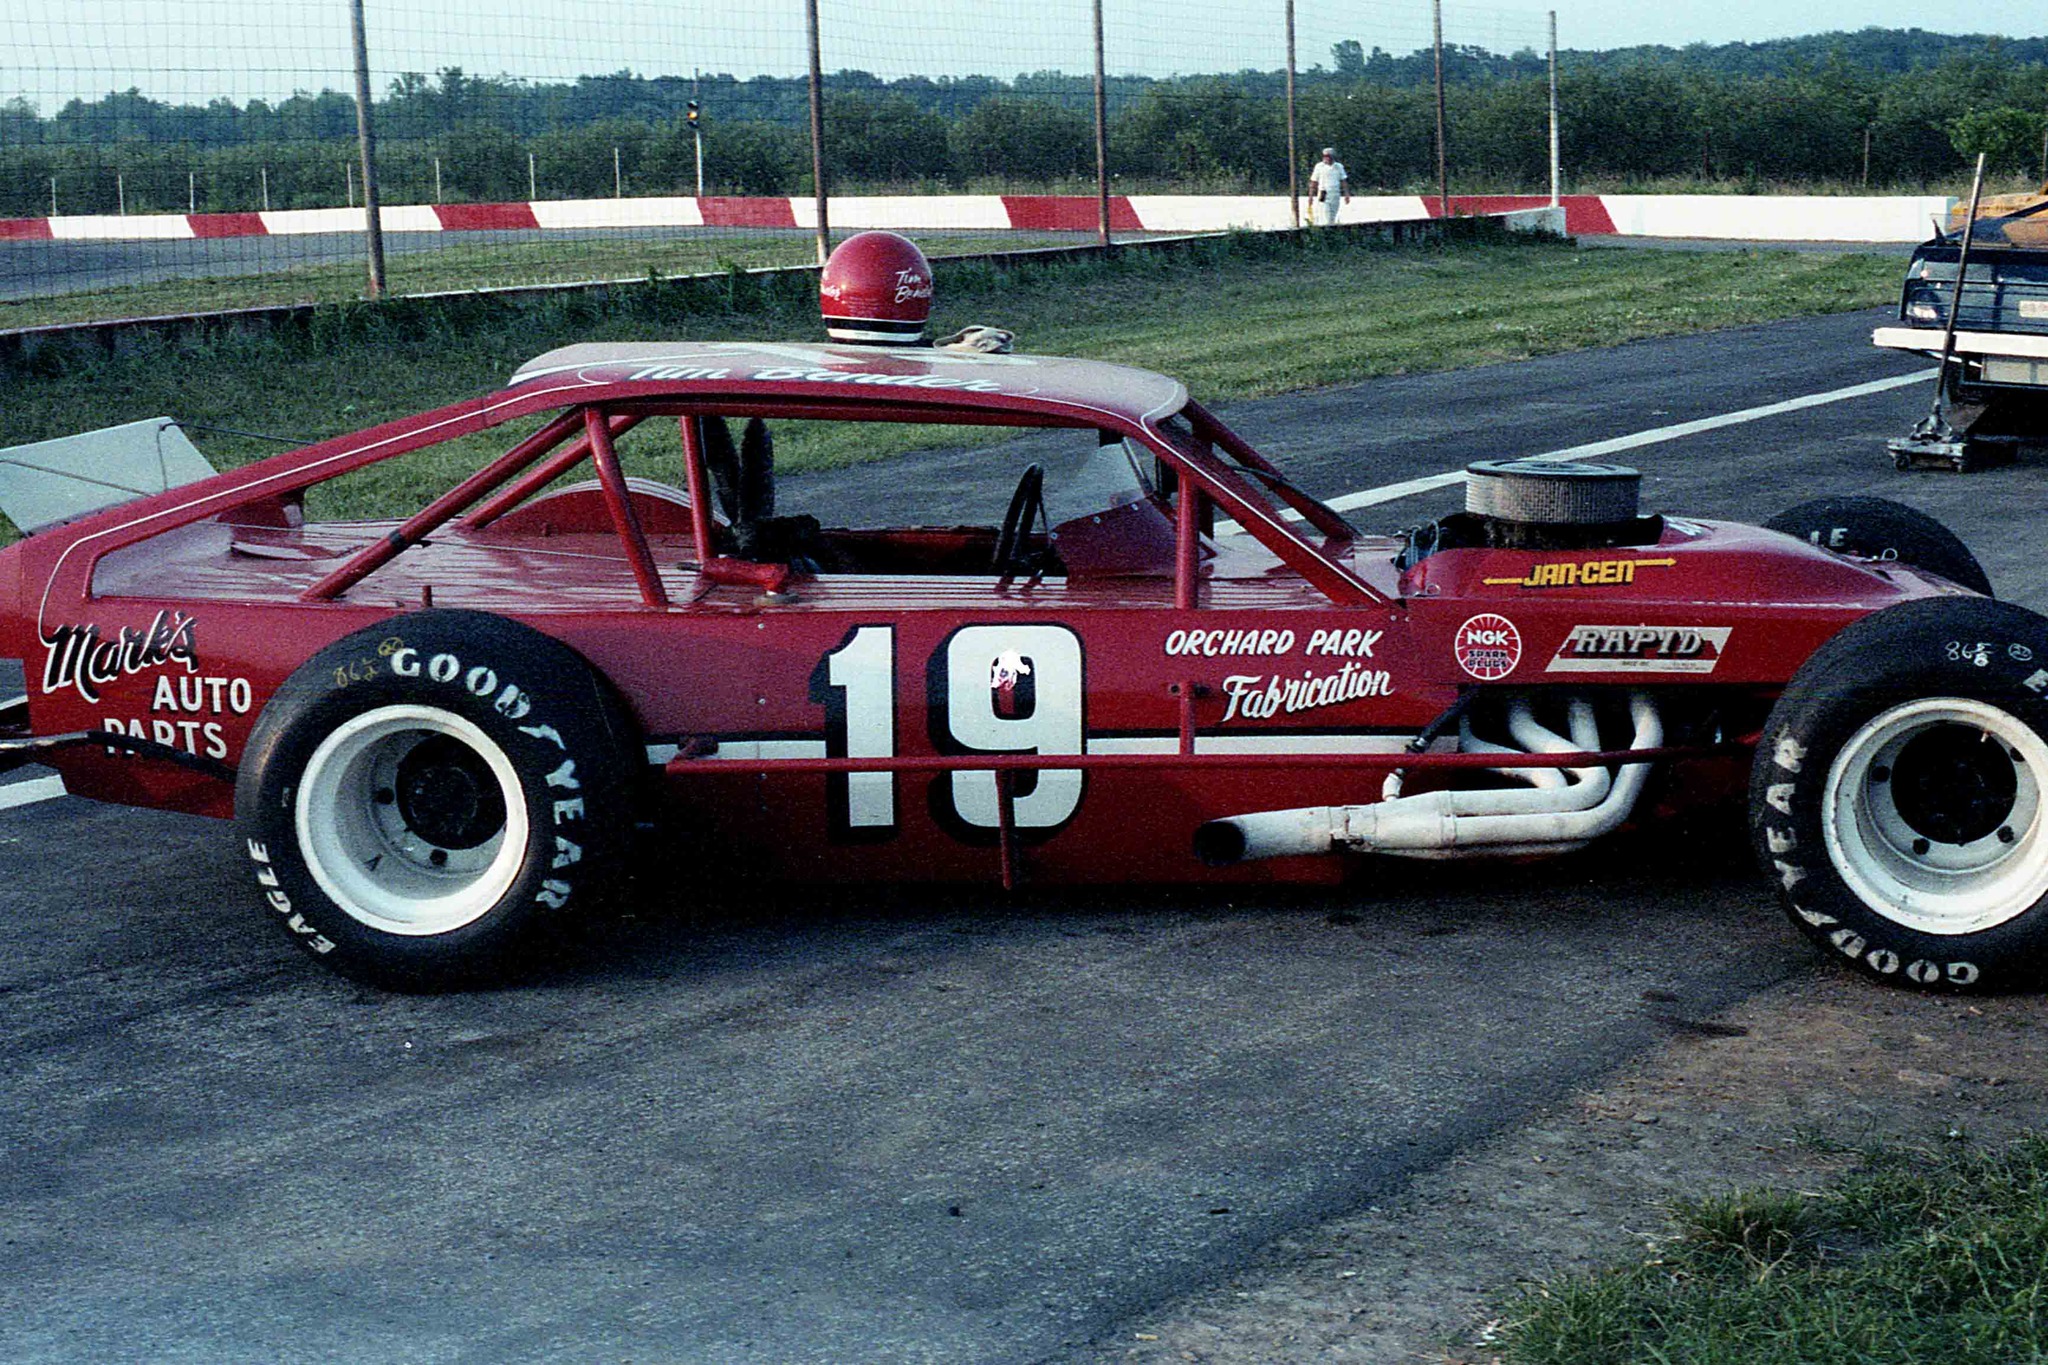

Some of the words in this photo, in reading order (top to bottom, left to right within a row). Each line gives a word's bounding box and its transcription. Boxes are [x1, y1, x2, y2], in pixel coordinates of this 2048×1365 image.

[895, 267, 921, 287] Tim
[628, 364, 732, 381] Tim
[39, 609, 200, 704] Mark's
[1164, 629, 1296, 657] ORCHARD
[1304, 629, 1384, 657] PARK
[1466, 629, 1509, 646] NGK
[1467, 649, 1508, 658] SPARK
[1573, 629, 1706, 657] RAPID
[1467, 659, 1508, 669] PLUGS
[152, 675, 252, 714] AUTO
[1221, 661, 1397, 724] Fabrication
[104, 717, 229, 760] PARTS
[824, 624, 1084, 832] 19
[390, 647, 585, 910] GOODYEAR
[1765, 734, 1981, 985] GOODYEAR
[247, 837, 337, 955] EAGLE
